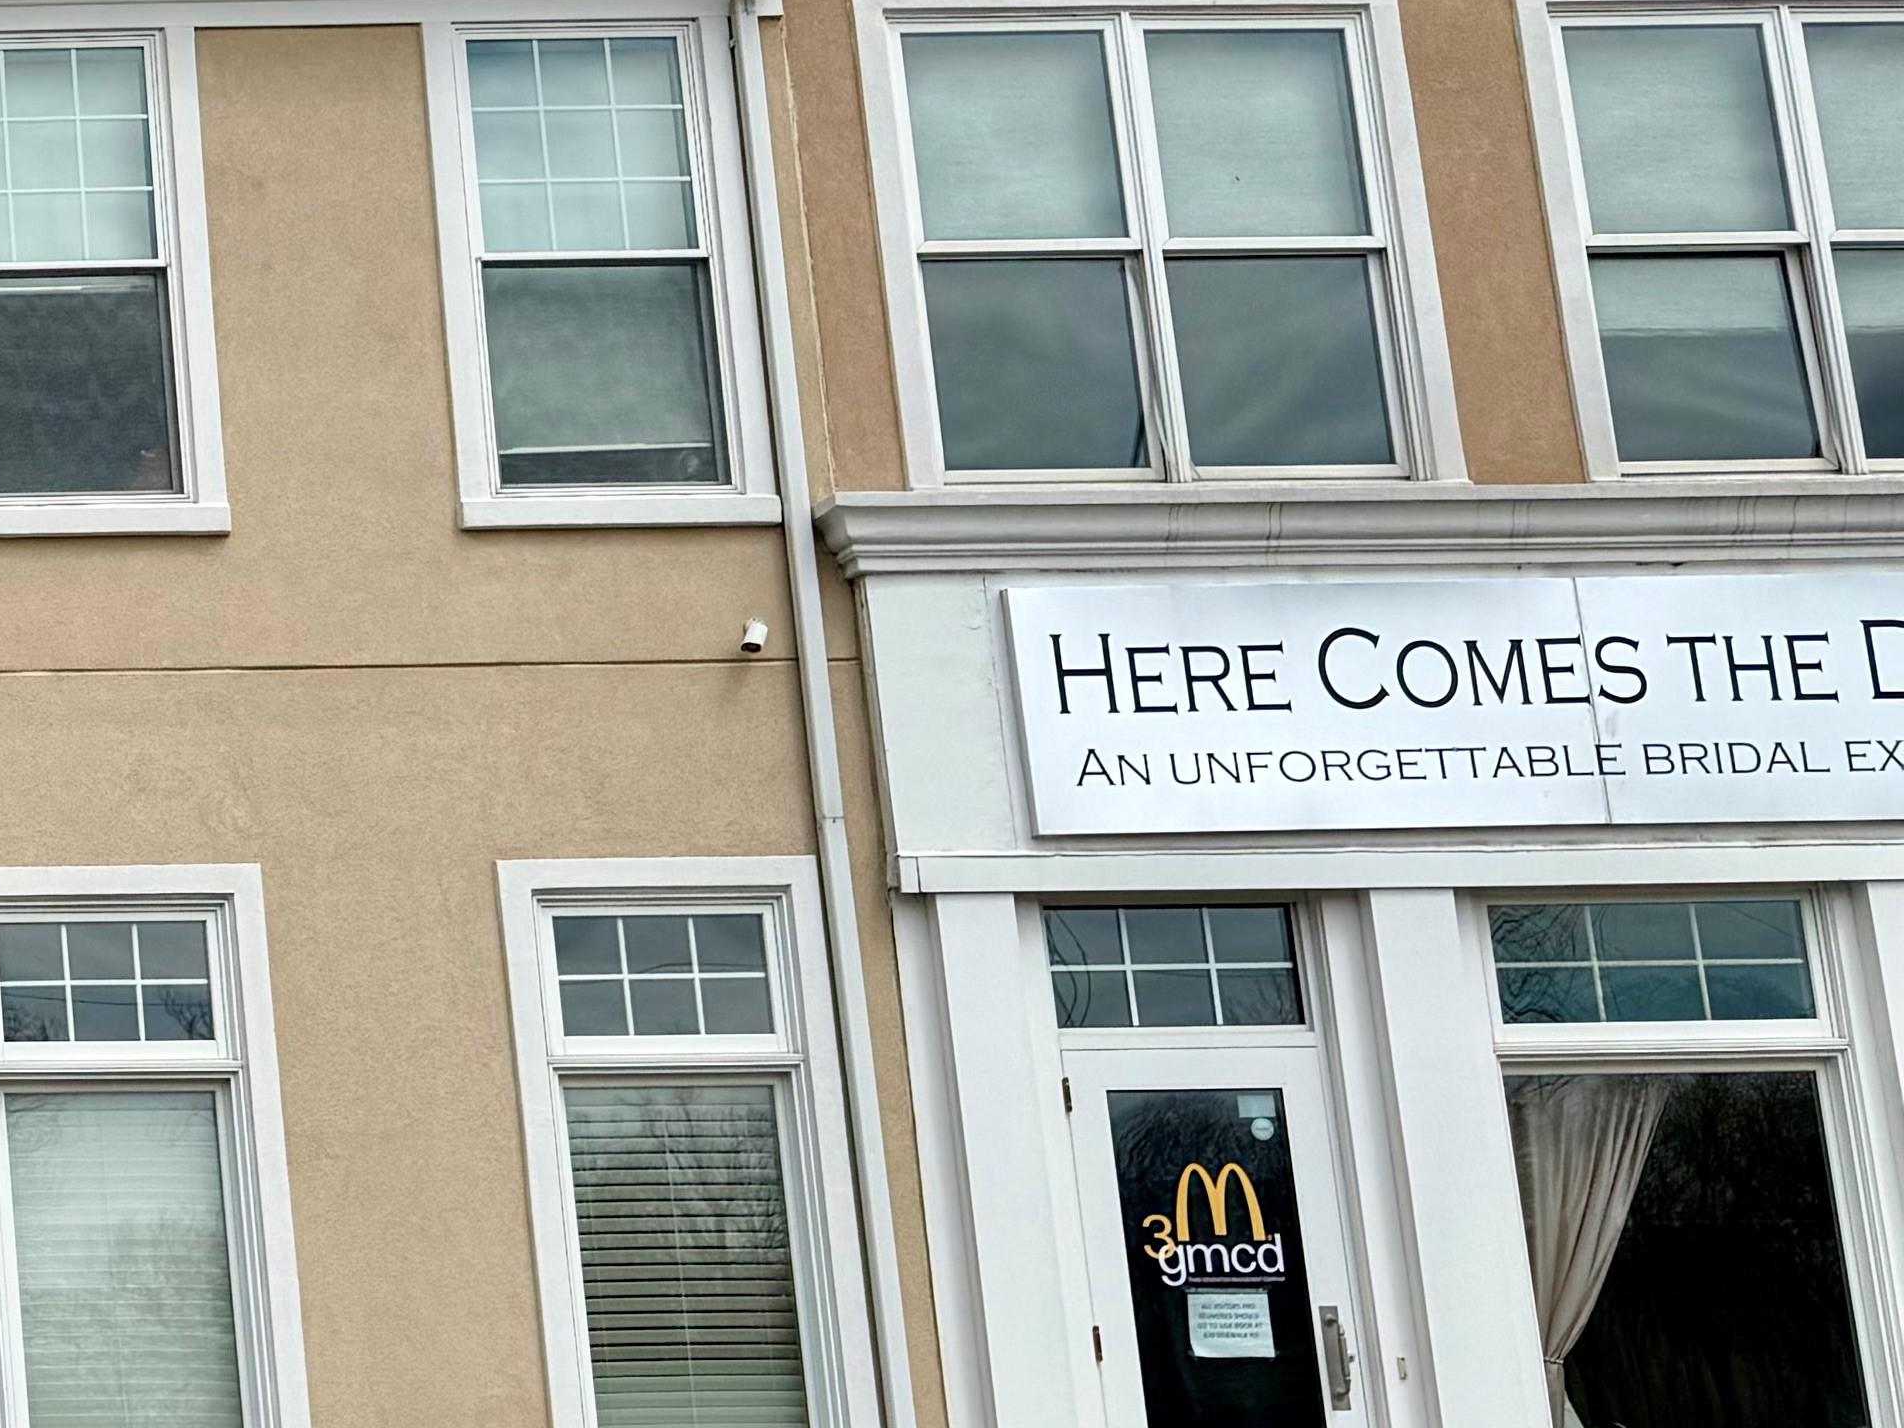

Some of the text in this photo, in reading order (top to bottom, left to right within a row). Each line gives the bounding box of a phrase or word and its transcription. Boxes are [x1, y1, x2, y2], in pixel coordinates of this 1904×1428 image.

[1049, 633, 1292, 715] HERE
[1318, 627, 1648, 711] COMES
[1666, 630, 1840, 703] THE
[1076, 748, 1152, 787] AN
[1169, 743, 1625, 786] UNFORGETTABLE
[1642, 740, 1832, 777] BRIDAL
[1158, 1232, 1285, 1287] gmcd
